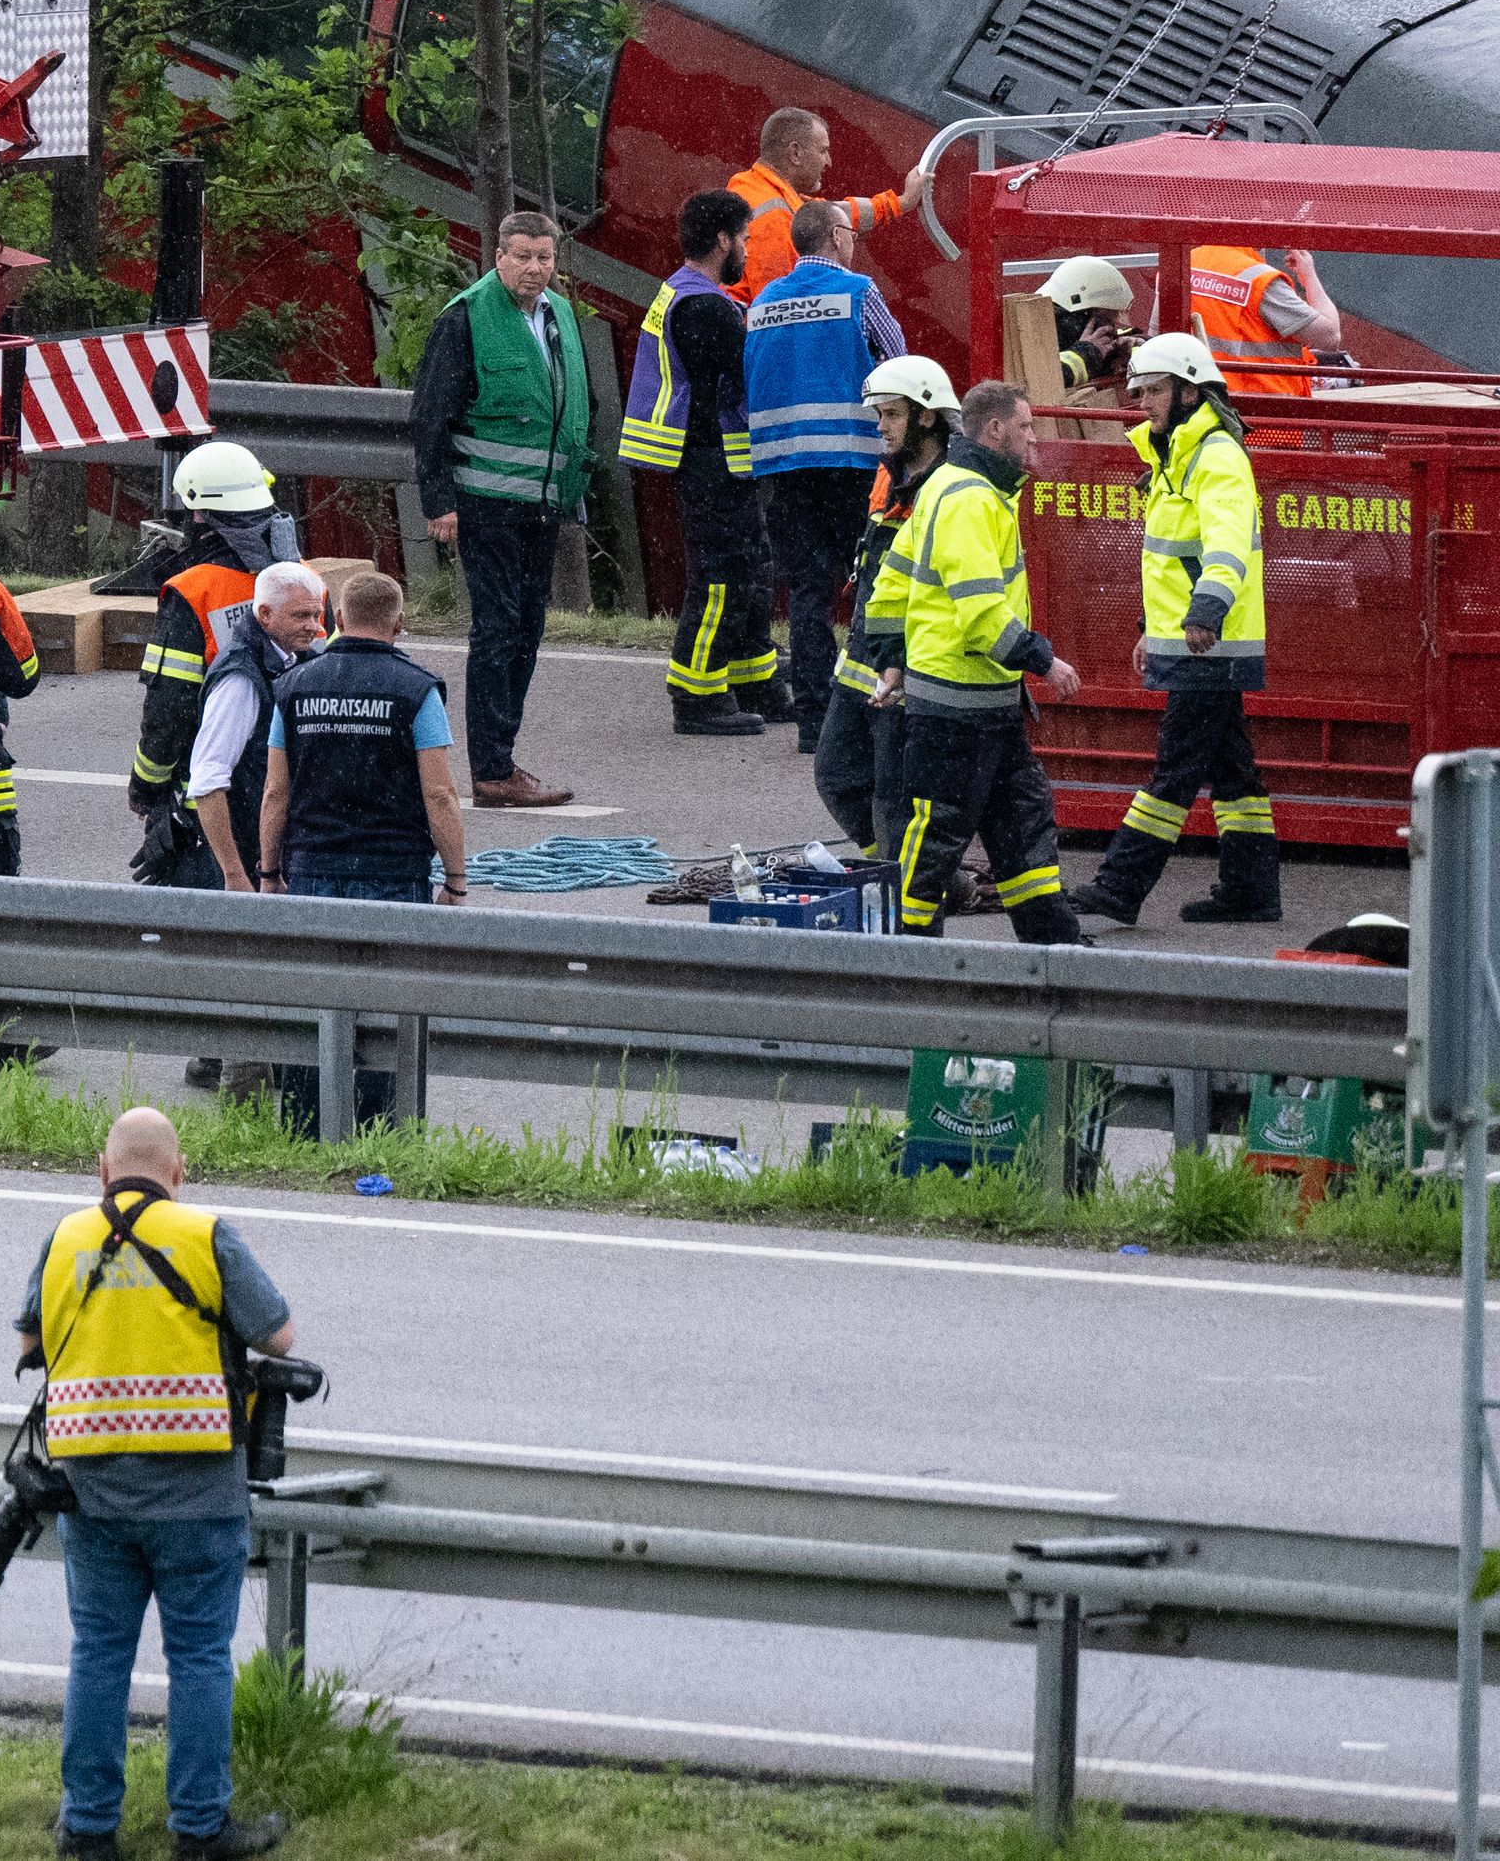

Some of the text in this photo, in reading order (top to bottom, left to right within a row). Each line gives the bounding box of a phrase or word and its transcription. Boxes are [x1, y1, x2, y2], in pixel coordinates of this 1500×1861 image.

[764, 299, 822, 315] PSNV
[752, 307, 841, 327] WM-SOG
[296, 698, 394, 719] LANDRATSAMT
[296, 722, 392, 737] GARMISCH-PARTENKIRCHEN
